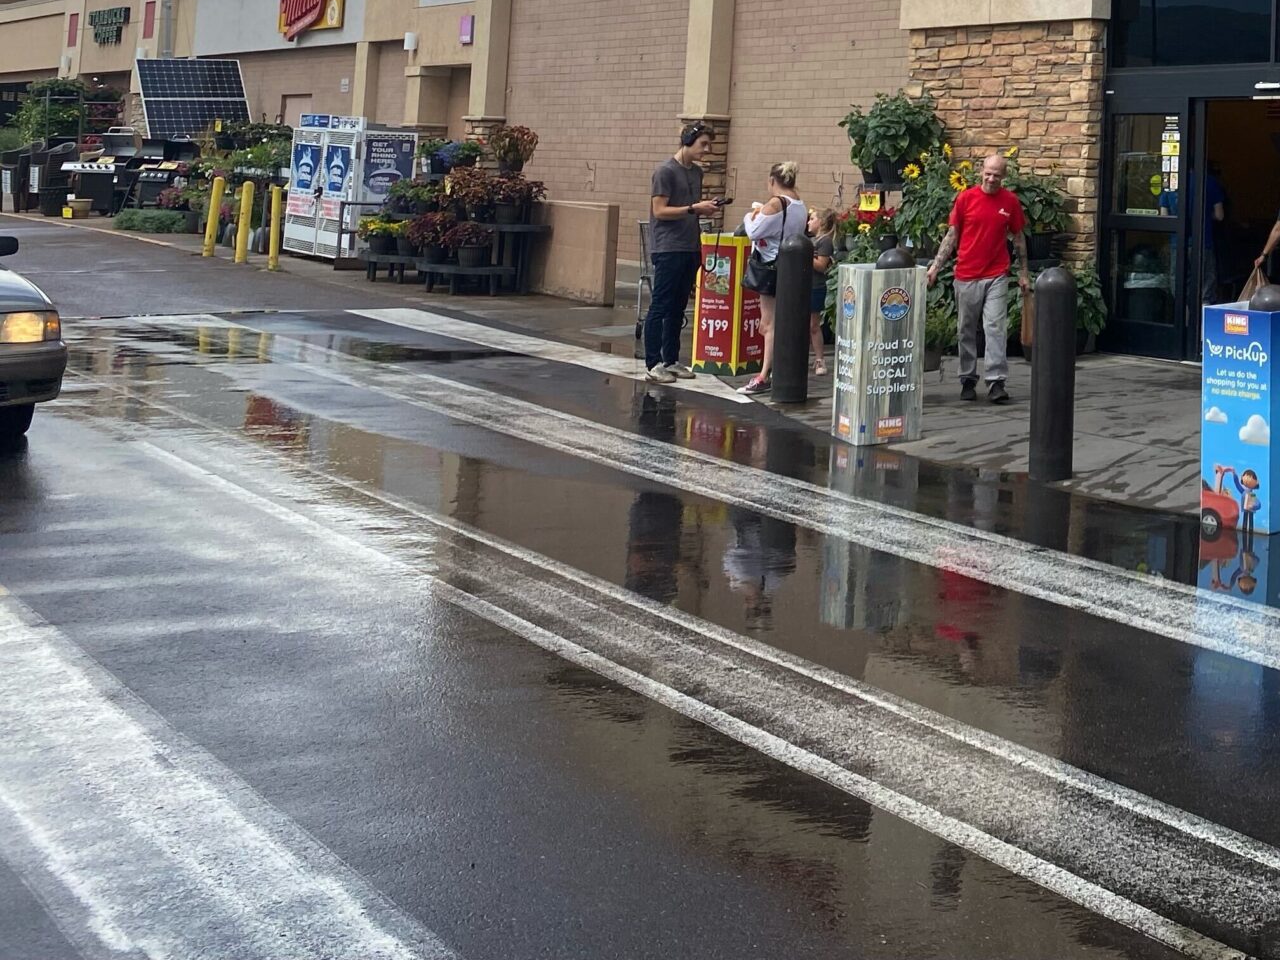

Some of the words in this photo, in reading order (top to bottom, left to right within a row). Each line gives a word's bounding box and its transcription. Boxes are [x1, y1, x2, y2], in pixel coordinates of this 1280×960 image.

[882, 288, 909, 303] COLORADO
[1226, 315, 1246, 325] KING
[867, 339, 899, 351] Proud
[902, 339, 914, 349] To
[871, 353, 913, 367] Support
[838, 365, 853, 378] LOCAL
[872, 367, 907, 380] LOCAL
[1216, 368, 1227, 377] Let
[1236, 370, 1246, 378] do
[1246, 372, 1257, 380] the
[866, 383, 916, 396] Suppliers
[1206, 377, 1236, 388] shopping
[1236, 380, 1246, 388] for
[1247, 382, 1260, 390] you
[878, 418, 902, 428] KING
